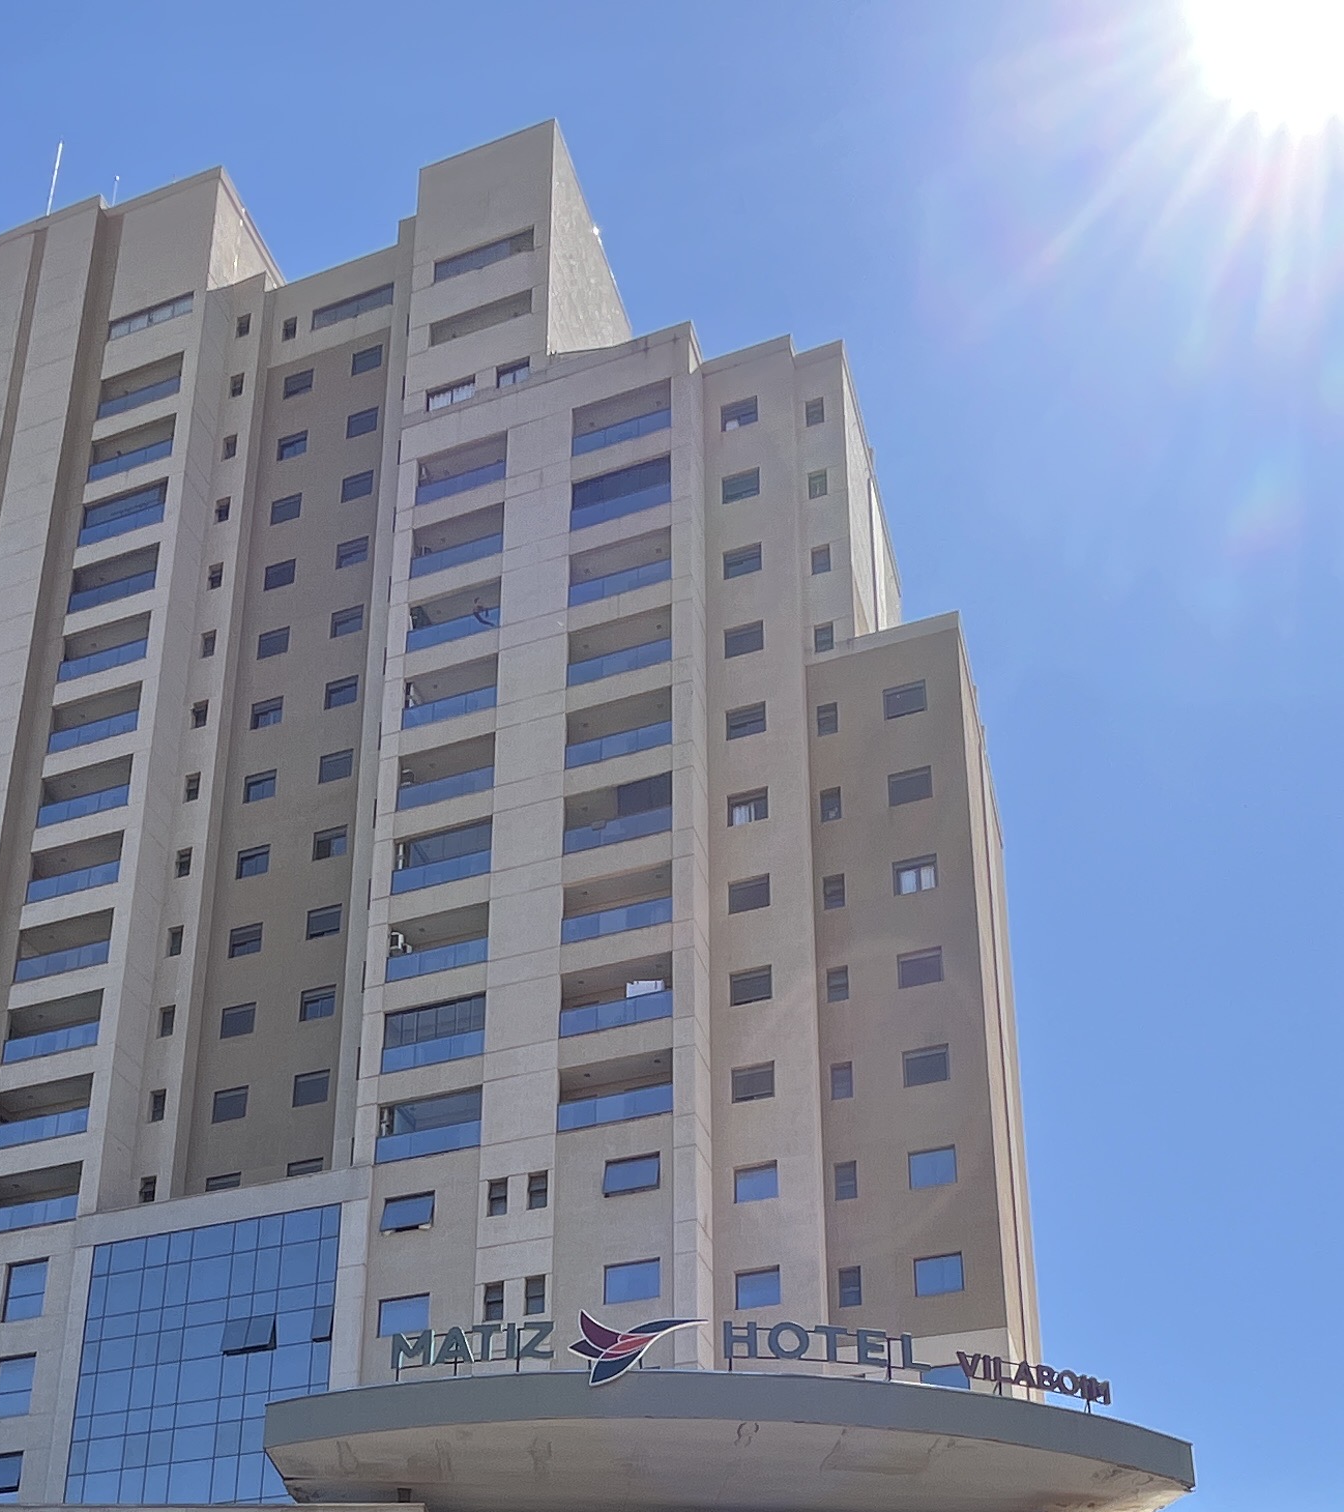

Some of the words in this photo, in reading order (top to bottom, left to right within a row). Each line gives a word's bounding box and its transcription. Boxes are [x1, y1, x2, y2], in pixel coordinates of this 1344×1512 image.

[391, 1321, 554, 1369] MATIZ
[723, 1320, 931, 1371] HOTEL
[956, 1351, 1111, 1406] VILABOIM
